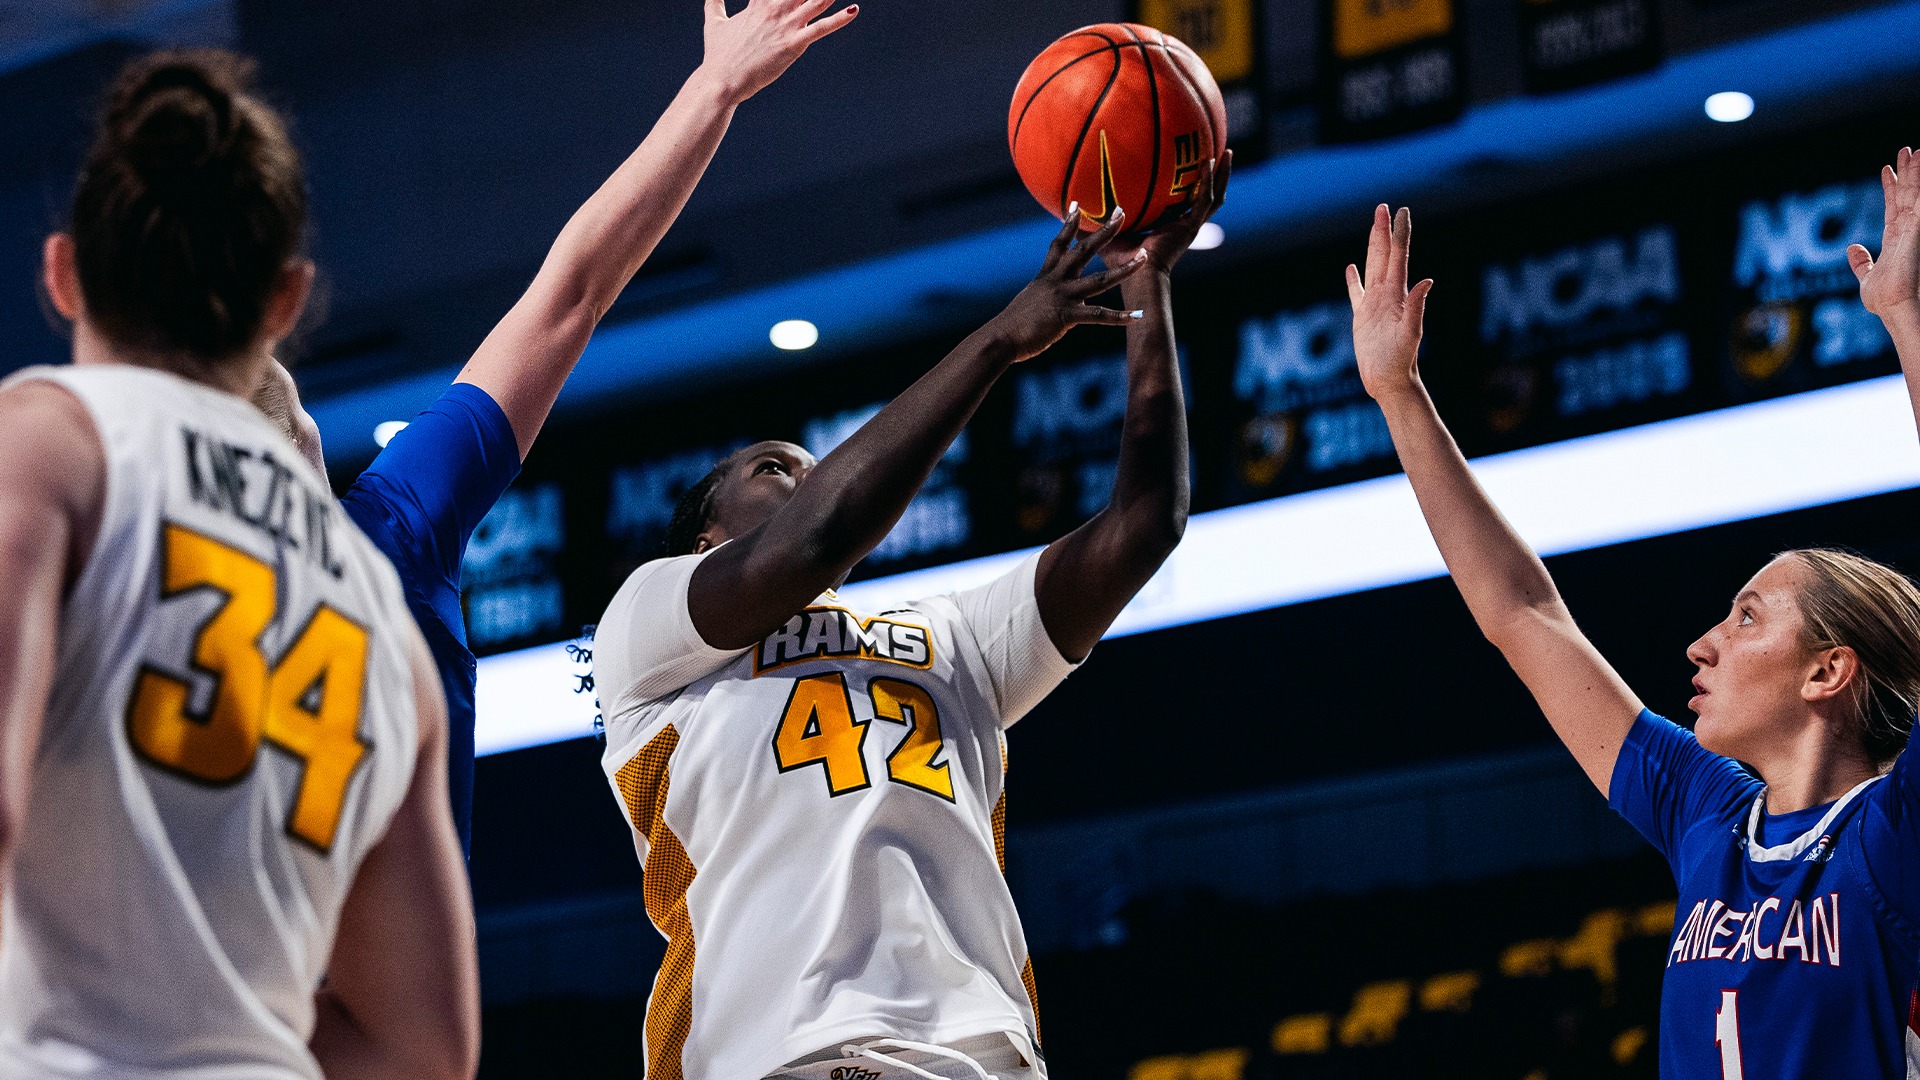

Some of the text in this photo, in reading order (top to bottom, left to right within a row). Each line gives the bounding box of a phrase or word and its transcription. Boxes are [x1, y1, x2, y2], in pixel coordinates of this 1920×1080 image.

[125, 518, 374, 856] 34
[753, 605, 935, 677] RAMS
[772, 670, 956, 804] 42
[1714, 988, 1744, 1080] 1
